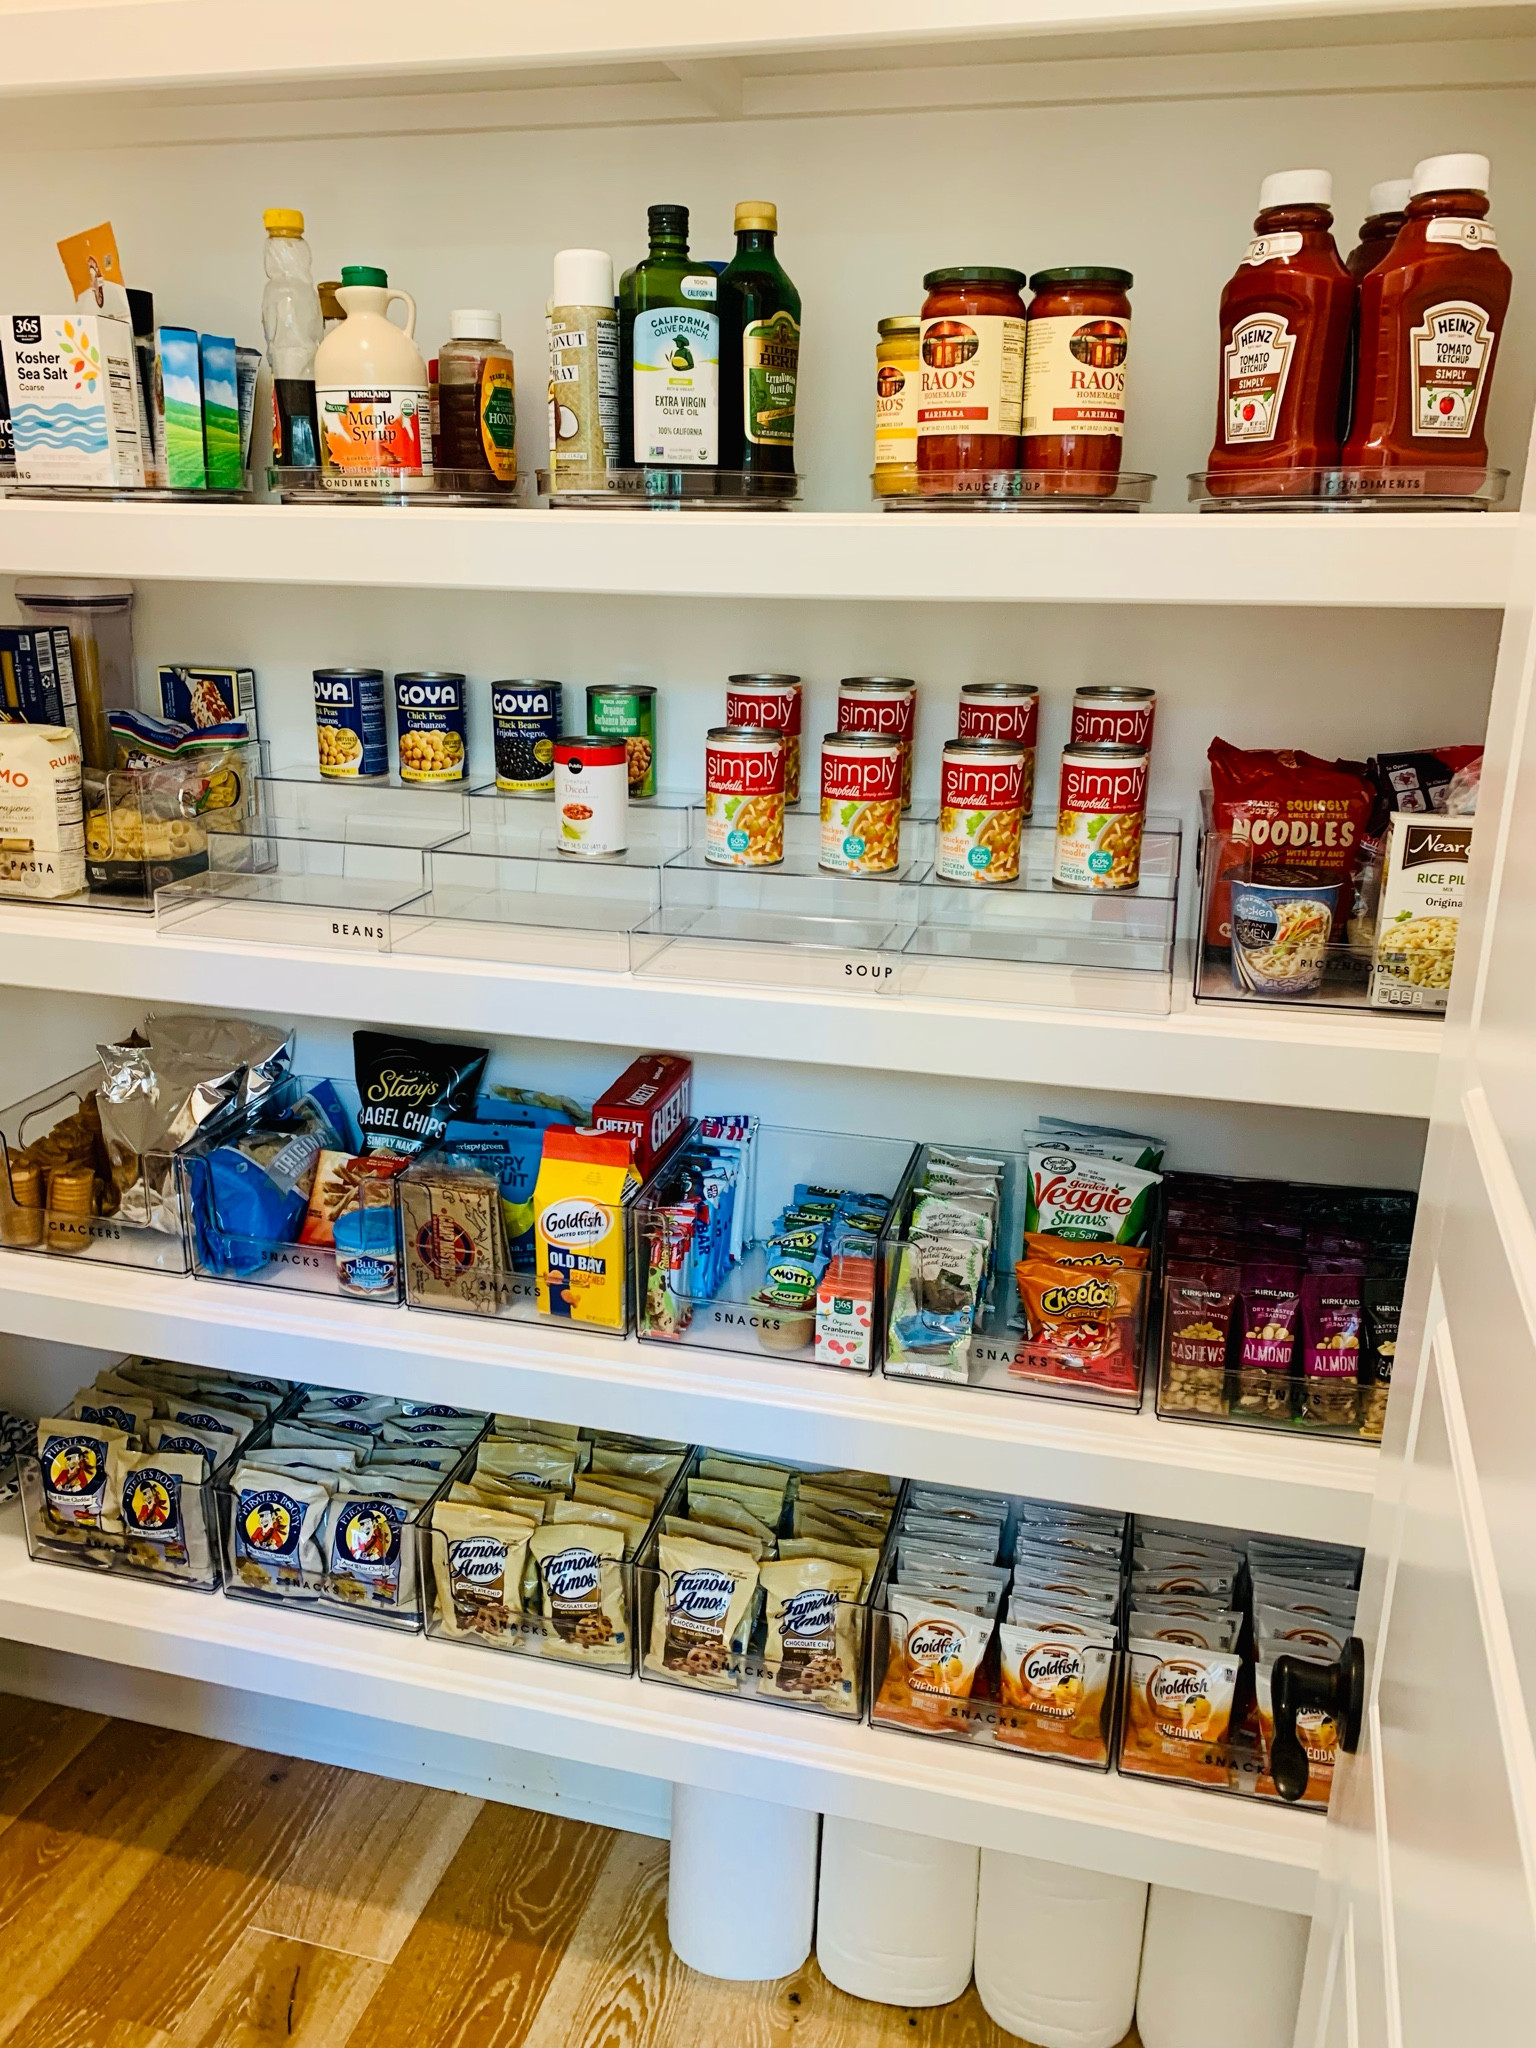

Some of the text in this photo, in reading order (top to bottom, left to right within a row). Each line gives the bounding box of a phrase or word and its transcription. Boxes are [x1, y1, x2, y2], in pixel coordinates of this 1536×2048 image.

[1469, 226, 1476, 235] 3
[1258, 242, 1264, 251] 3
[16, 319, 38, 333] 365
[651, 316, 710, 331] CALIFORNIA
[1438, 319, 1475, 335] HEINZ
[654, 324, 708, 339] OLIVE RANCH
[1241, 331, 1272, 345] HEINZ
[1437, 344, 1472, 355] TOMATO
[16, 351, 60, 364] Kosher
[1240, 353, 1270, 363] TOMATO
[1437, 354, 1469, 363] KETCHUP
[18, 367, 68, 380] Sea Salt
[1240, 363, 1267, 373] KETCHUP
[1436, 369, 1466, 379] SIMPLY
[19, 383, 45, 391] Coarse
[921, 371, 975, 391] RAO'S
[1070, 371, 1124, 391] RAO'S
[1238, 378, 1265, 388] SIMPLY
[655, 396, 706, 408] EXTRA VIRGIN
[924, 391, 967, 399] HOMEMADE
[1077, 391, 1121, 399] HOMEMADE
[349, 411, 394, 426] Maple
[663, 408, 684, 416] OLIVE
[924, 410, 964, 418] MARINARA
[1077, 411, 1117, 419] MARINARA
[352, 427, 396, 444] Syrup
[658, 427, 702, 436] 100% CALIFORNIA
[319, 479, 391, 488] CONDIMENTS
[608, 480, 641, 489] OLIVE
[1326, 480, 1421, 490] CONDIMENTS
[399, 686, 455, 704] GOYA
[493, 695, 548, 713] GOYA
[603, 704, 625, 715] Organic
[323, 708, 338, 716] Peas
[429, 712, 446, 720] Peas
[727, 697, 793, 727] simply
[841, 702, 910, 732] simply
[407, 721, 446, 729] Garbanzos
[499, 721, 540, 729] Black Beans
[594, 715, 637, 725] Garbanzo Beans
[959, 707, 1030, 738] simply
[1075, 712, 1149, 743] simply
[497, 729, 545, 738] Frijoles Negros
[708, 754, 778, 785] simply
[824, 759, 896, 791] simply
[565, 784, 588, 794] Diced
[708, 776, 743, 791] Campbell's
[824, 781, 860, 797] Campbell's
[947, 767, 1022, 799] simply
[1067, 769, 1145, 802] simply
[947, 791, 988, 807] Campbell's
[1067, 794, 1111, 810] Campbell's
[1287, 800, 1349, 811] SQUIGGLY
[943, 835, 969, 845] chicken
[1232, 819, 1355, 847] NOODLES
[943, 844, 965, 853] noodle
[1061, 839, 1090, 849] chicken
[1410, 835, 1465, 854] Near
[1061, 848, 1086, 857] noodle
[11, 861, 54, 873] PASTA
[1417, 873, 1465, 885] RICE PIL
[1426, 898, 1463, 909] Origina
[332, 923, 384, 938] BEANS
[845, 964, 893, 977] SOUP
[368, 1070, 439, 1107] Stacy's
[360, 1107, 447, 1138] BAGEL CHIPS
[367, 1135, 394, 1148] SIMPLY
[481, 1143, 504, 1151] green
[273, 1131, 333, 1177] ORIGINAL
[1034, 1172, 1132, 1215] Veggie
[1067, 1180, 1109, 1192] garden
[546, 1211, 602, 1232] Goldfish
[1051, 1209, 1108, 1227] Straws
[48, 1221, 121, 1240] CRACKERS
[1057, 1229, 1098, 1240] Sea Salt
[261, 1250, 320, 1268] SNACKS
[356, 1259, 378, 1268] BLUE
[550, 1251, 604, 1274] OLD BAY
[346, 1264, 391, 1276] DIAMOND
[570, 1273, 605, 1285] SEASONED
[480, 1280, 541, 1297] SNACKS
[1254, 1288, 1295, 1298] KIRKLAND
[1042, 1281, 1116, 1313] Cheetos
[1321, 1298, 1360, 1306] KIRKLAND
[836, 1301, 851, 1309] 365
[1266, 1307, 1295, 1315] ROASTED
[714, 1311, 781, 1330] SNACKS
[1207, 1312, 1228, 1320] SALTED
[822, 1325, 864, 1337] Cranberries
[976, 1348, 1048, 1367] SNACKS
[1171, 1342, 1225, 1362] CASHEWS
[1243, 1344, 1292, 1363] ALMOND
[1276, 1390, 1321, 1405] NUTS
[46, 1437, 90, 1458] PIRATE'S
[241, 1492, 300, 1528] PIRATE'S BOOTY
[340, 1504, 377, 1526] PIRATE'S
[449, 1540, 510, 1564] Famous
[450, 1561, 502, 1578] Amos
[541, 1555, 602, 1580] Famous
[283, 1577, 339, 1595] SNACKS
[547, 1575, 596, 1597] Amos
[669, 1571, 736, 1597] Famous
[487, 1589, 501, 1597] CHIP
[670, 1594, 726, 1613] Amos
[776, 1592, 840, 1618] Famous
[490, 1618, 548, 1637] SNACKS
[673, 1618, 720, 1635] CHOCOLATE CHIP
[779, 1610, 834, 1635] Amos
[912, 1636, 961, 1654] Goldfish
[712, 1660, 774, 1680] SNACKS
[1028, 1658, 1079, 1678] Goldfish
[951, 1707, 1018, 1728] SNACKS
